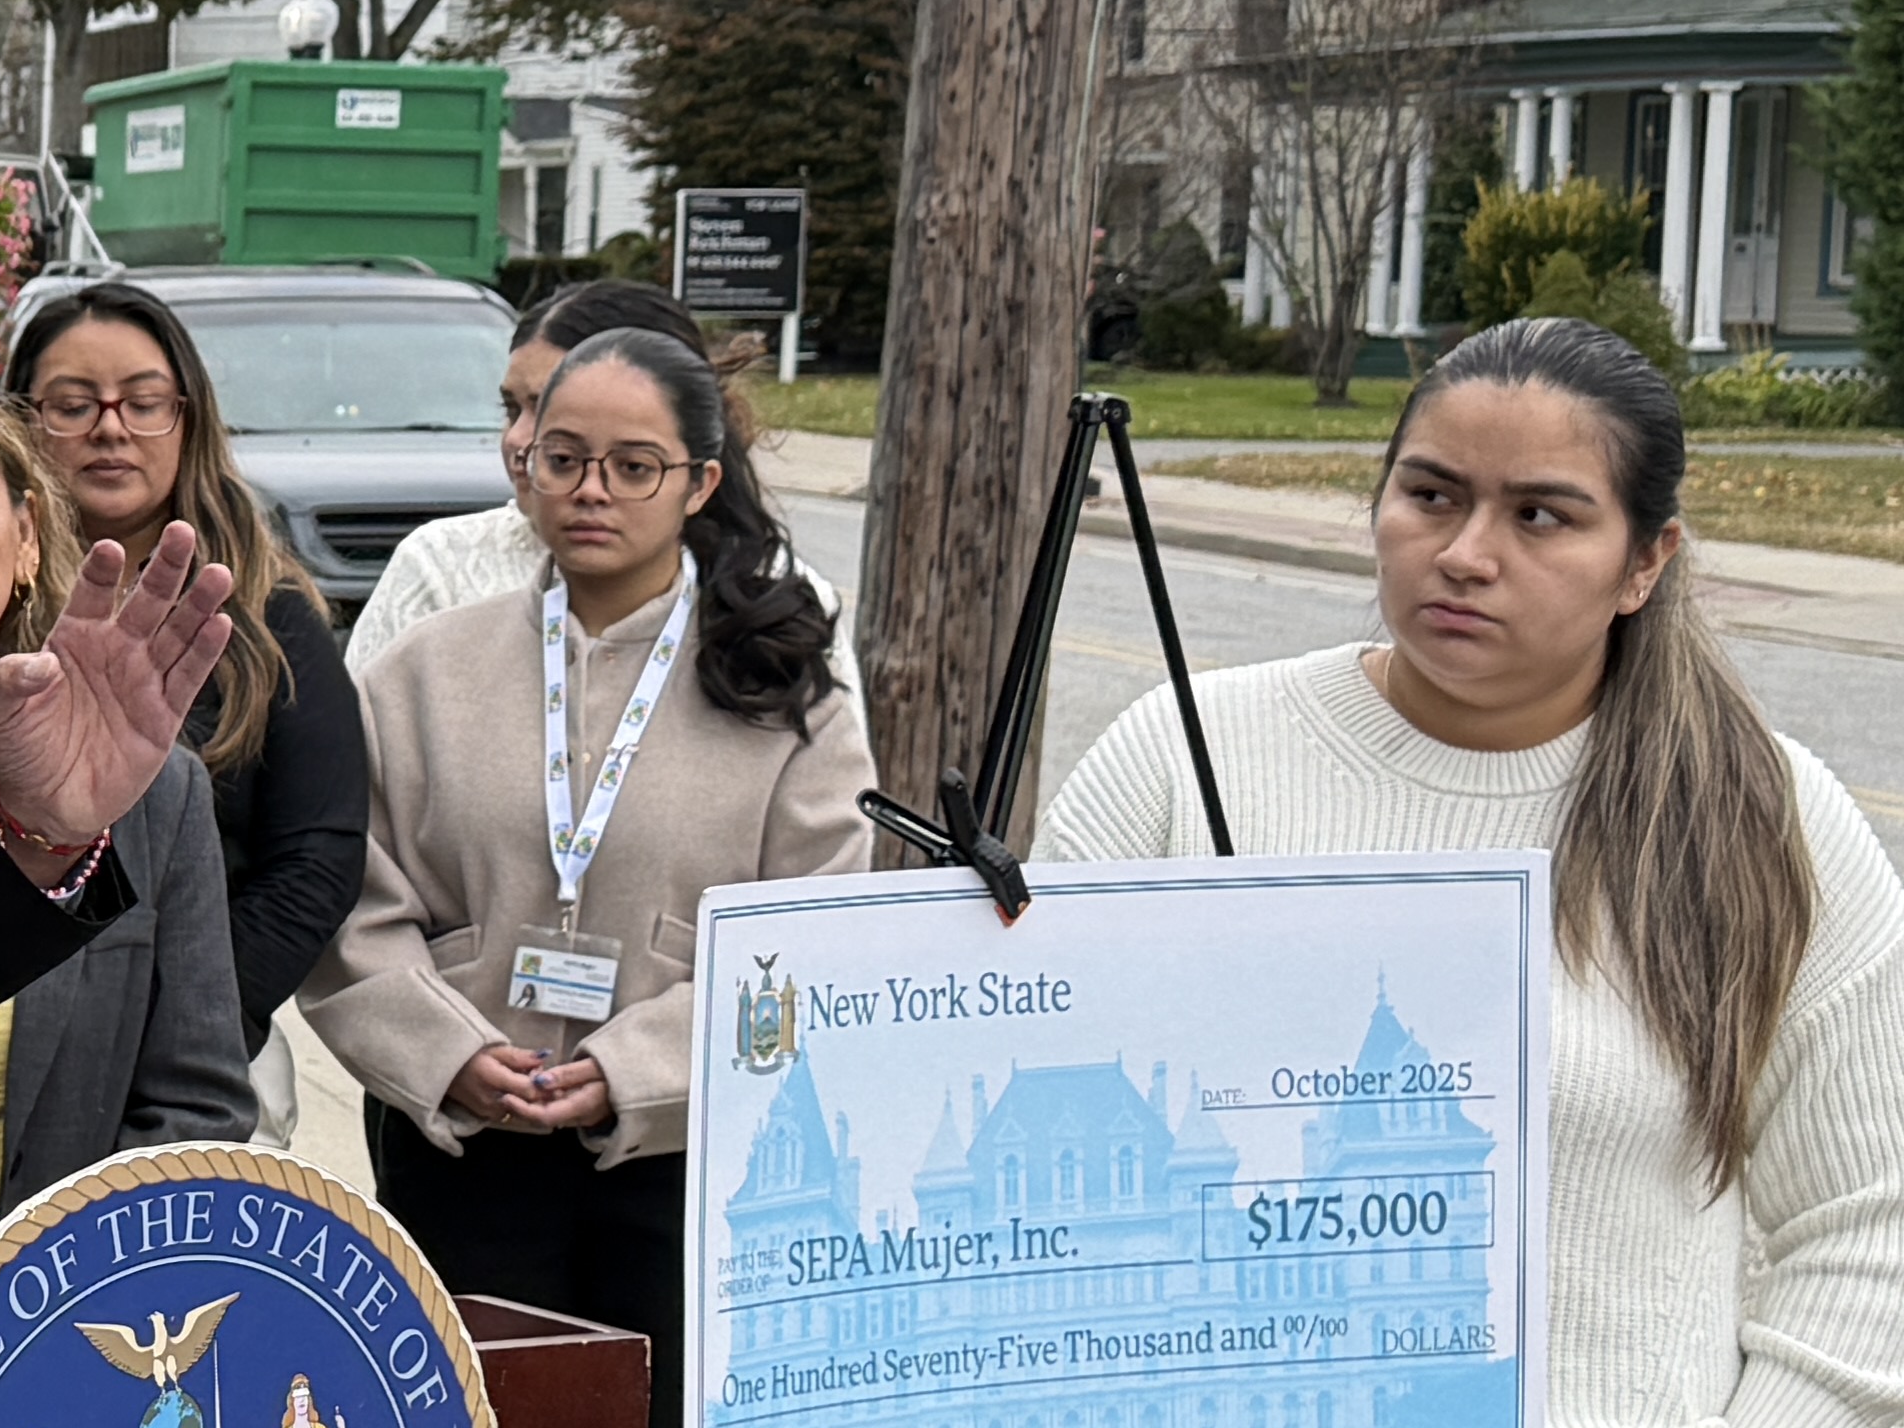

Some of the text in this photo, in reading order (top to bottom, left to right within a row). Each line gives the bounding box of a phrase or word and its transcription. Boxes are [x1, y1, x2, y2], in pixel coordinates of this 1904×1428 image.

[807, 970, 1073, 1030] New York State
[1272, 1066, 1391, 1098] October
[1401, 1062, 1472, 1093] 2025
[787, 1217, 1079, 1286] SEPA Mujer, Inc.
[1248, 1191, 1447, 1250] $175,000
[9, 1240, 80, 1323] OF
[97, 1188, 216, 1265] THE
[231, 1192, 400, 1330] STATE
[387, 1325, 451, 1414] OF
[723, 1373, 766, 1407] One
[771, 1355, 877, 1399] Hundred
[883, 1334, 1058, 1380] Seventy-Five
[1065, 1321, 1212, 1365] Thousand
[1221, 1317, 1276, 1352] and
[1382, 1324, 1496, 1354] DOLLARS
